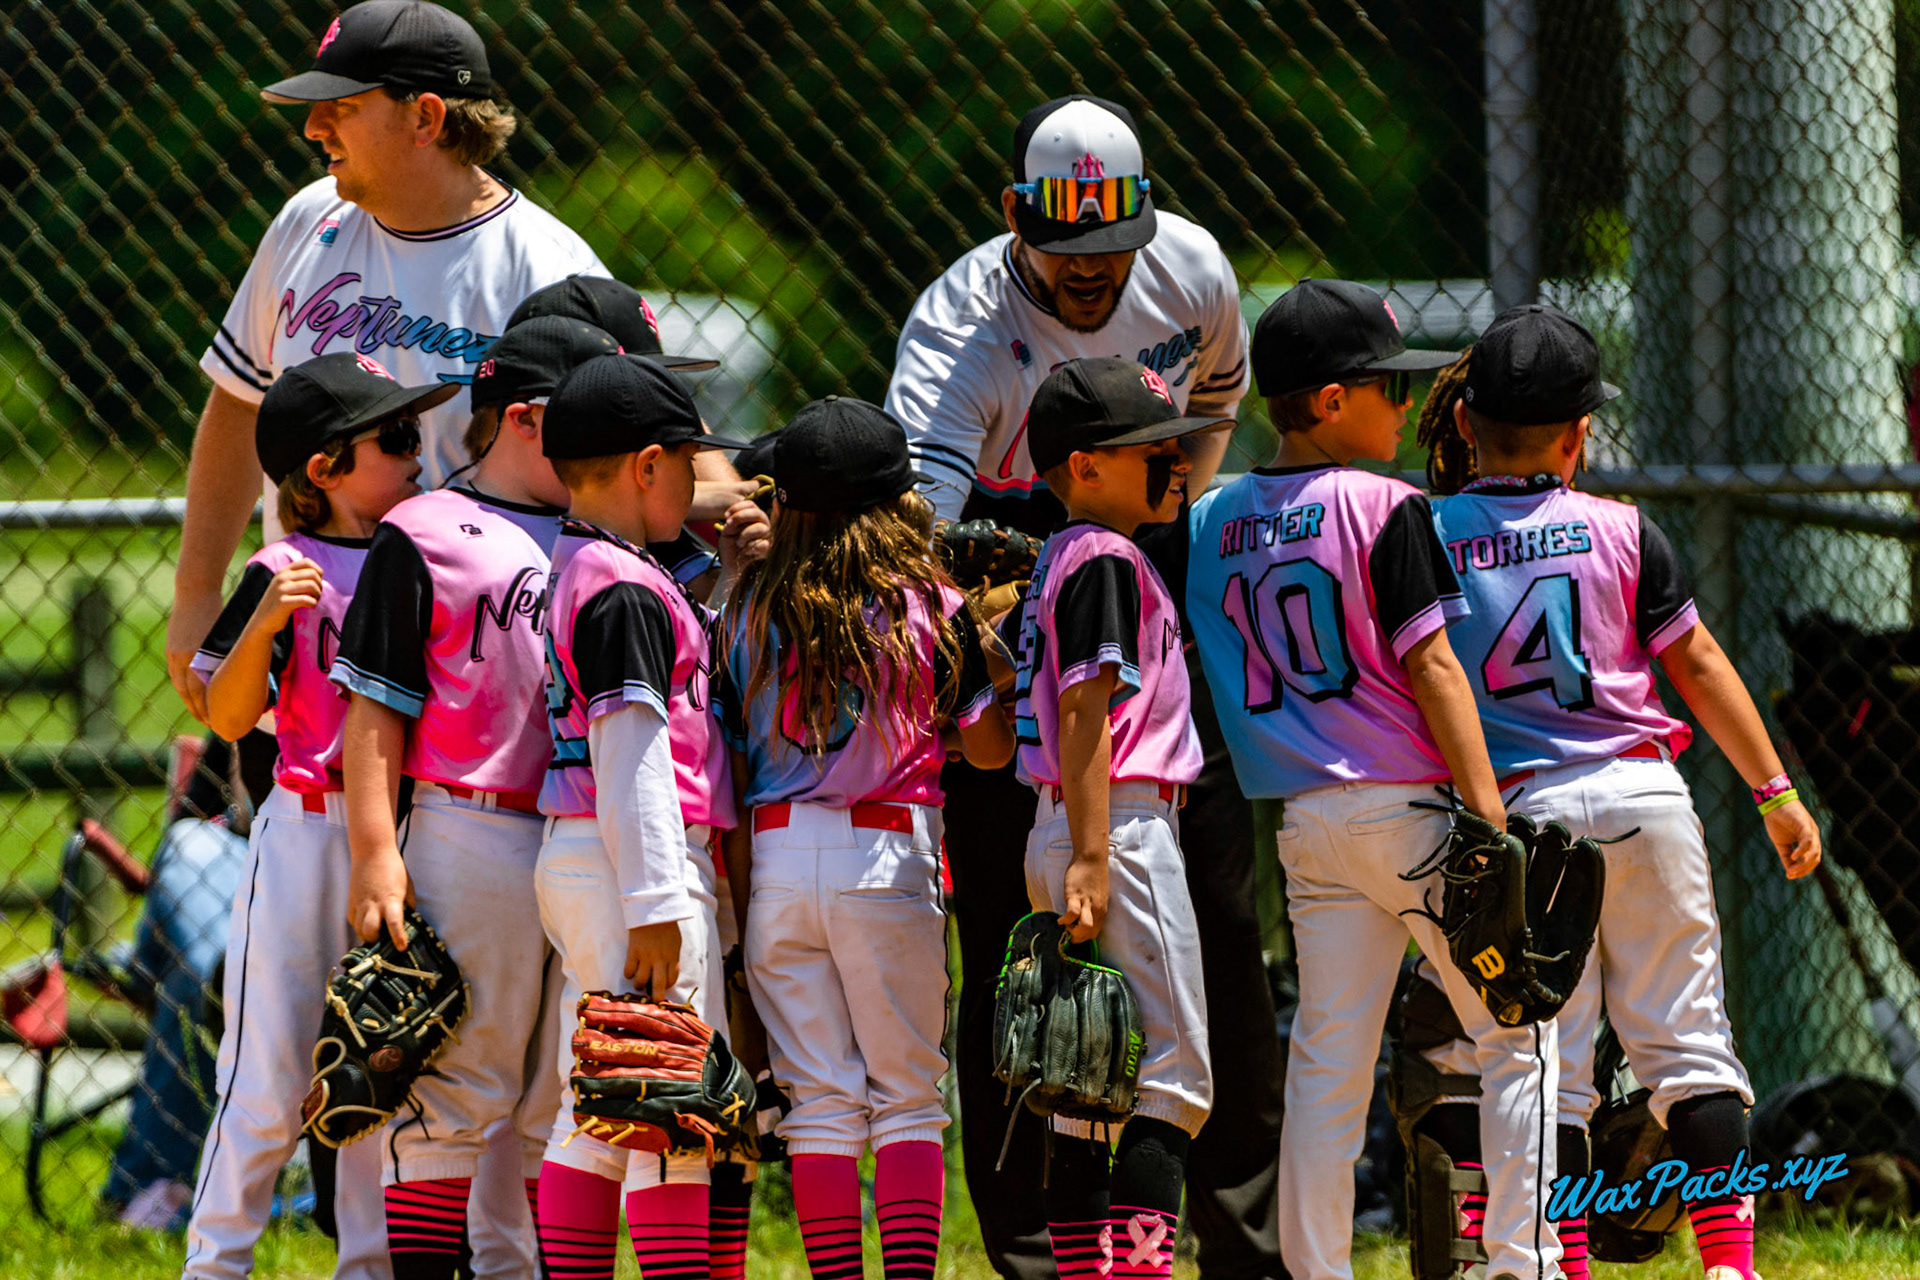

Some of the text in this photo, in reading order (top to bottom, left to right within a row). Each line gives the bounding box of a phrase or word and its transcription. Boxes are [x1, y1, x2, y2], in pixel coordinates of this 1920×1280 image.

[1219, 502, 1326, 560] RITTER
[1447, 520, 1592, 575] TORRES
[1221, 556, 1361, 716] 10
[1480, 572, 1597, 713] 4
[589, 1040, 659, 1057] EASTON
